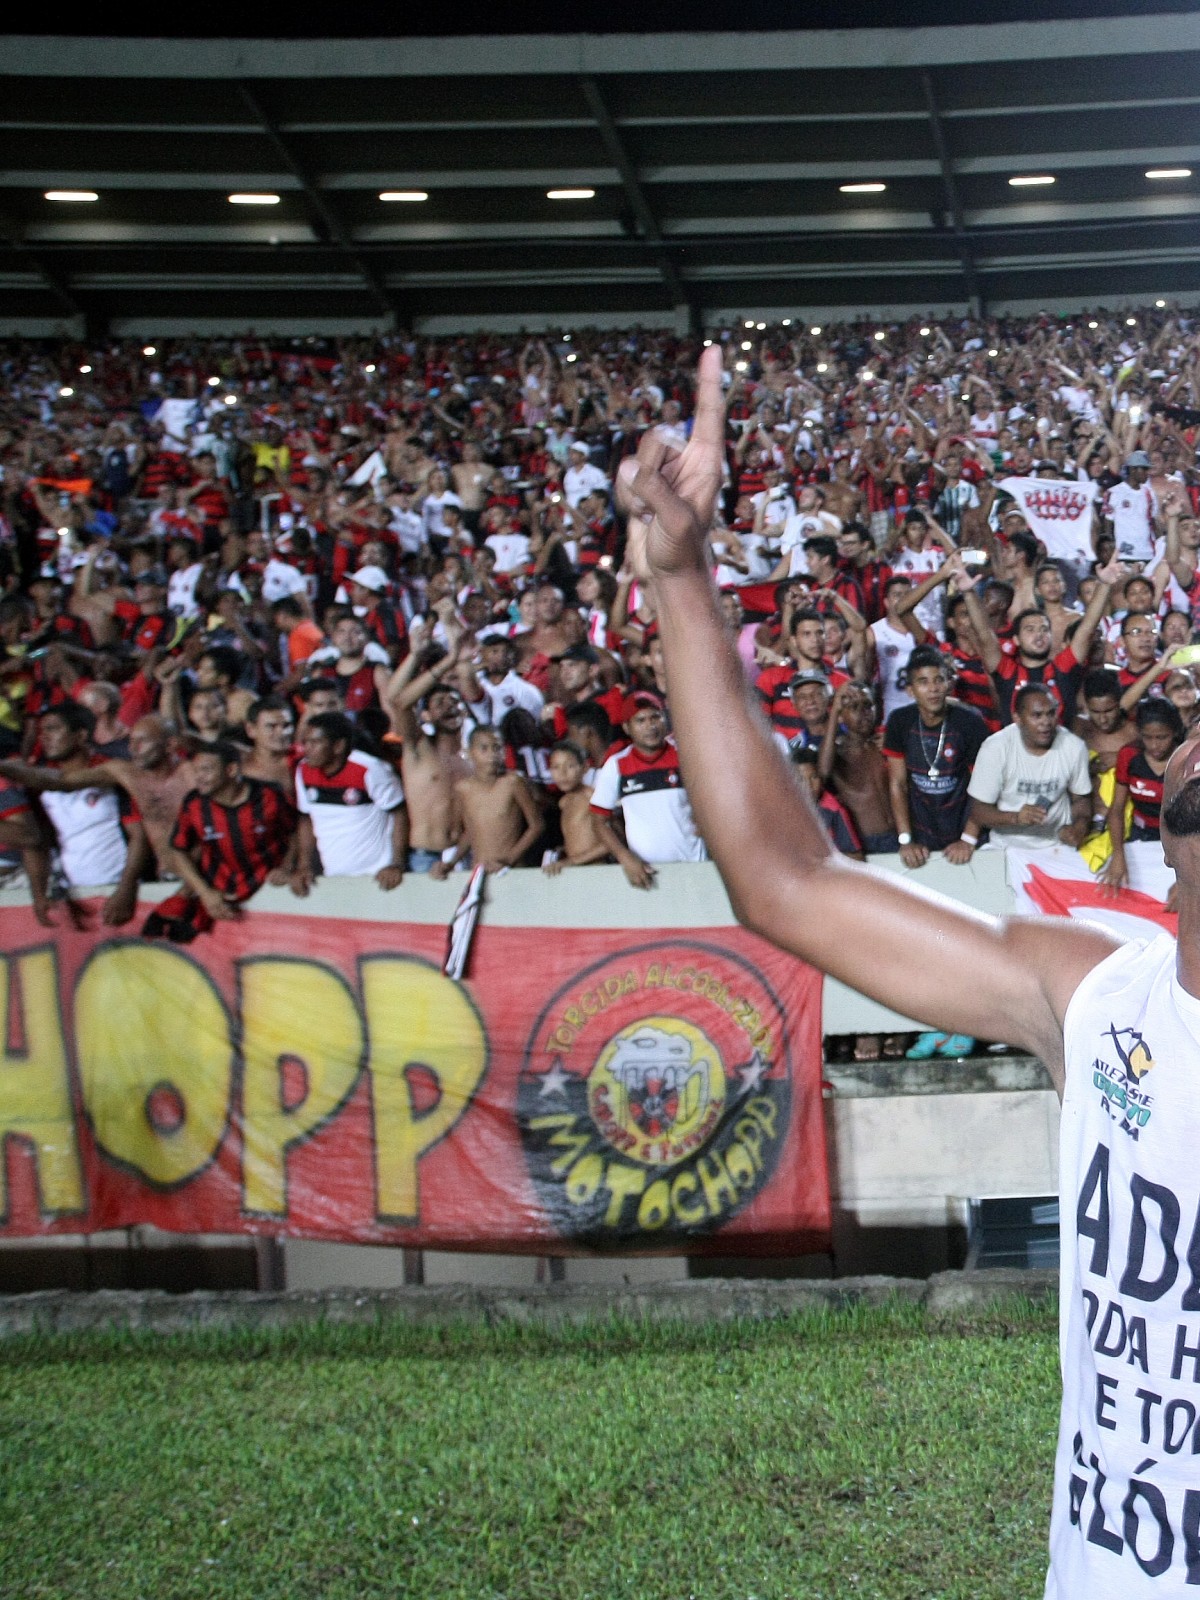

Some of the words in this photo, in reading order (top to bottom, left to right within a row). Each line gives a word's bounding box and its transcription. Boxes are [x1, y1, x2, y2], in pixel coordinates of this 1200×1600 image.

[545, 969, 639, 1053] TORCIDA
[529, 1096, 778, 1230] MOTOCHOPP
[1082, 1288, 1150, 1375] ODA
[1096, 1372, 1120, 1431] E
